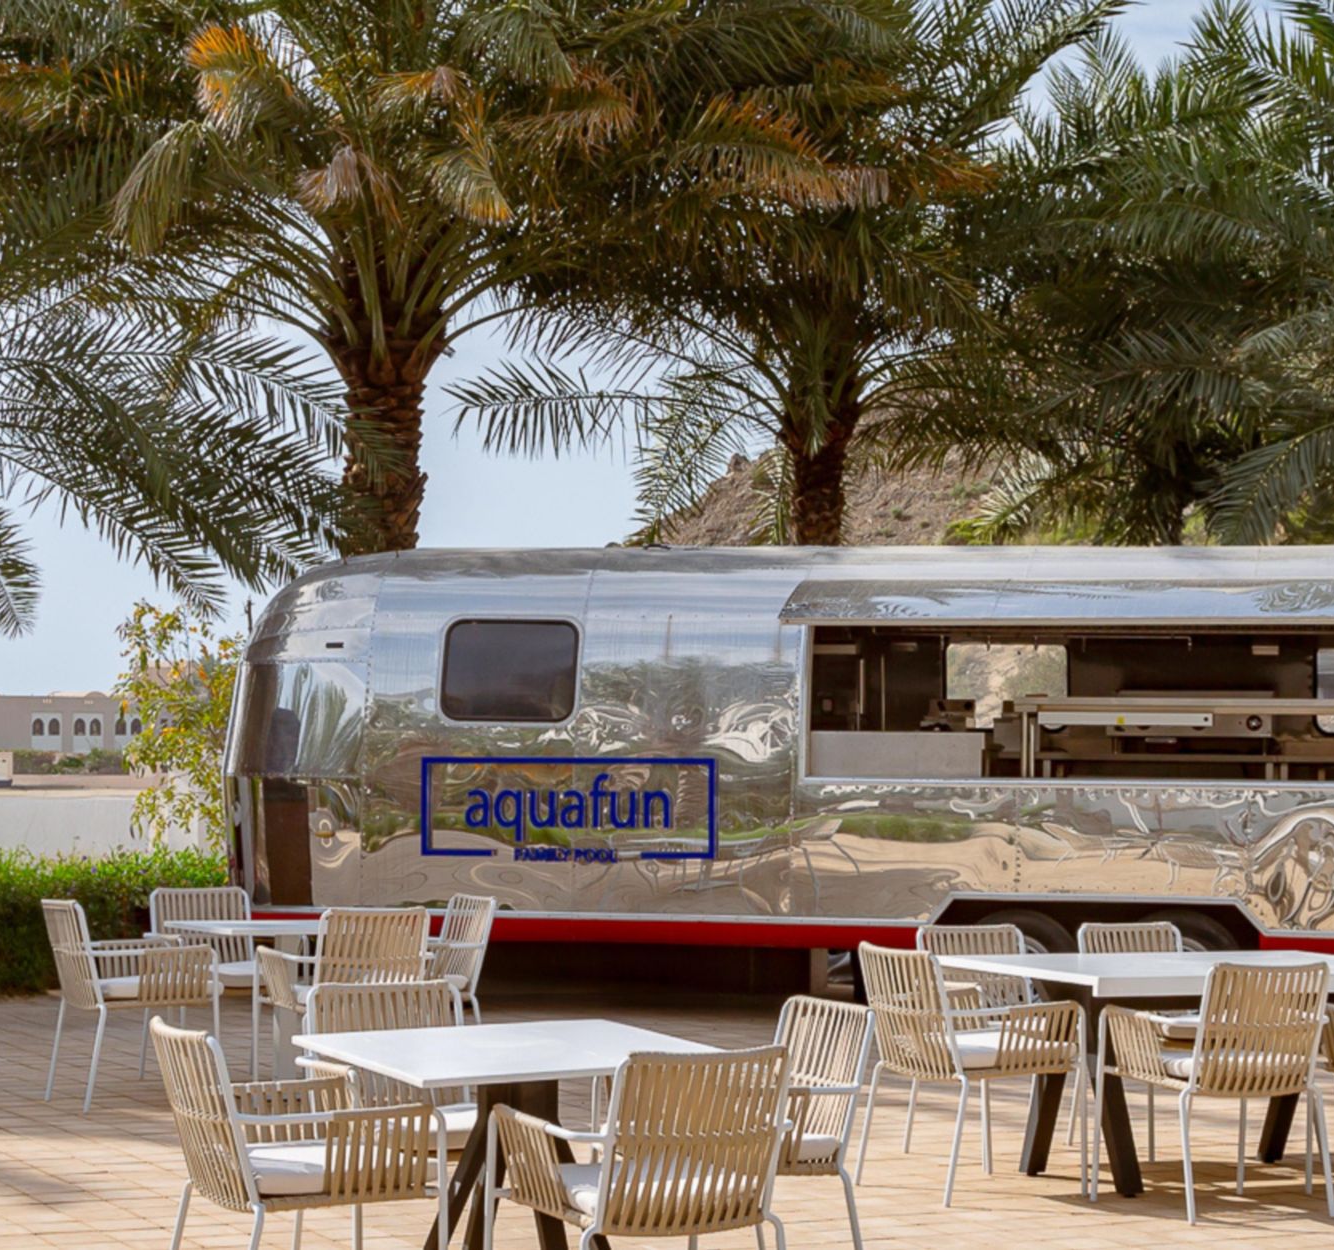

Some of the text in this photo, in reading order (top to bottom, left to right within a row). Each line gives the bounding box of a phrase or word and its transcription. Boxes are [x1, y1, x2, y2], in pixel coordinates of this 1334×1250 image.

[464, 773, 671, 842] aquafun
[513, 848, 618, 864] FAMILY POOL
